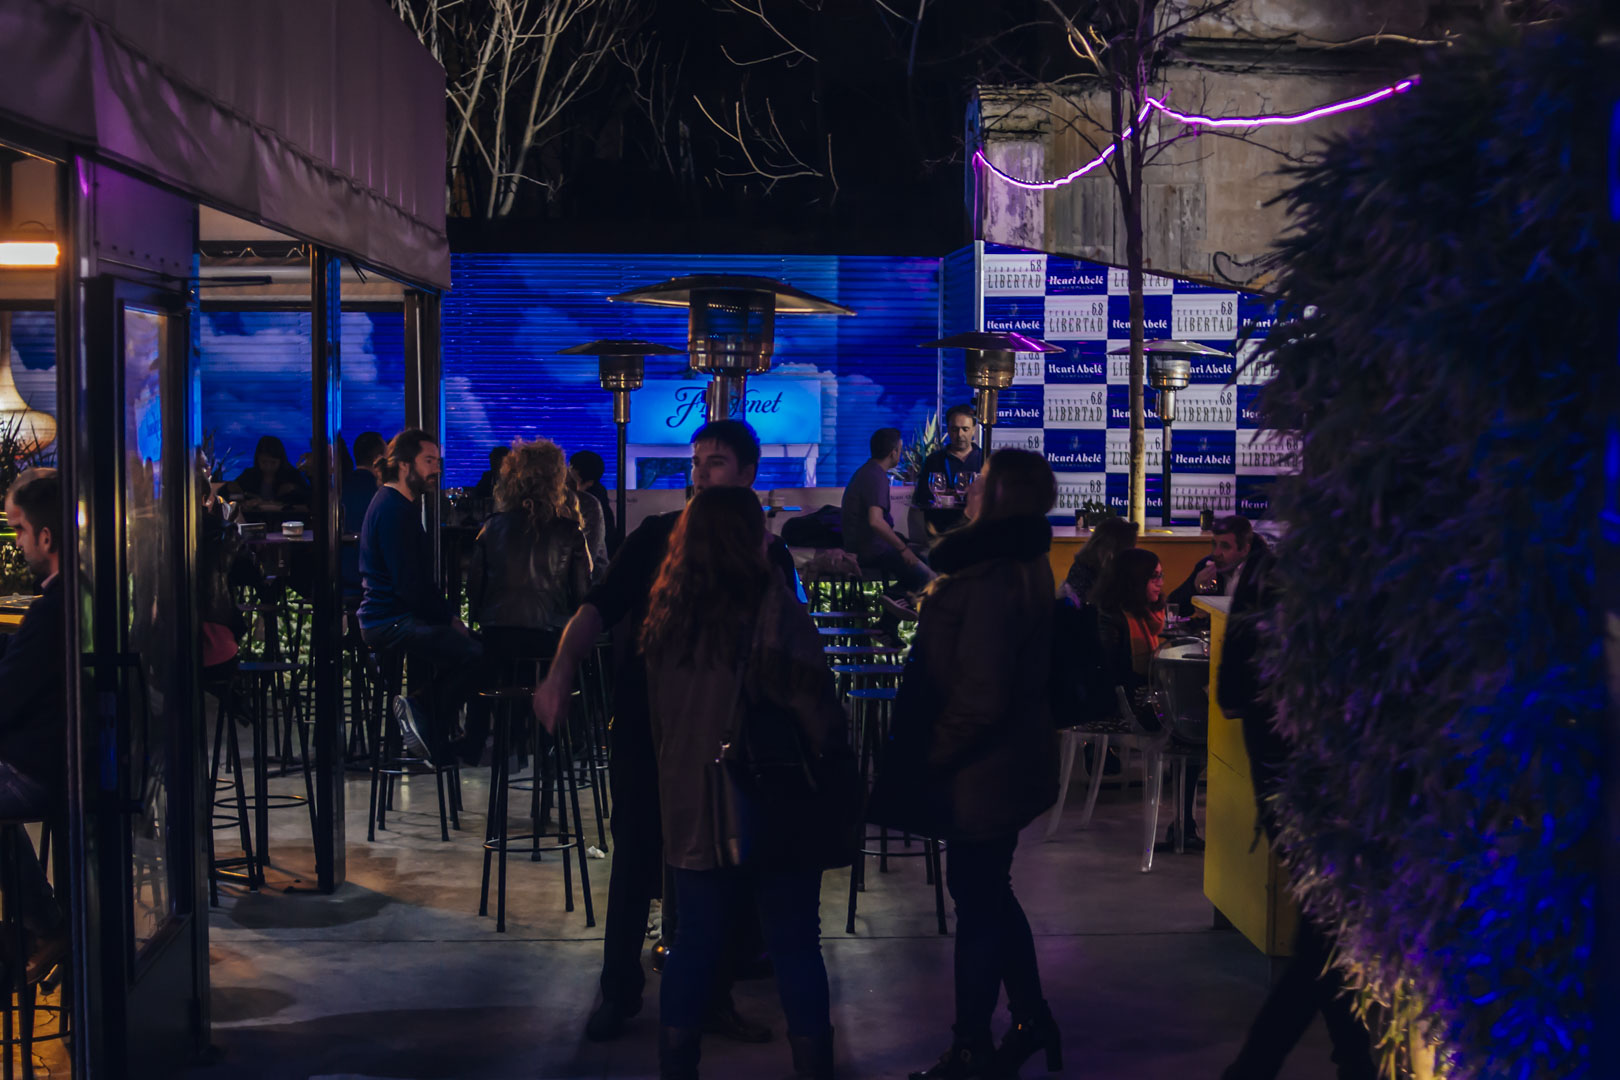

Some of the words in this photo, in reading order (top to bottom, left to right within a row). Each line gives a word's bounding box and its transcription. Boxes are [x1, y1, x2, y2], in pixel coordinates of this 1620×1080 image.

[988, 274, 1041, 289] LIBERTAD
[1049, 275, 1076, 285] Henri
[1077, 275, 1104, 285] Abelé
[1091, 302, 1104, 316] 6.8
[1220, 302, 1233, 315] 6.8
[987, 320, 1013, 329] Henri
[1016, 320, 1040, 329] Abelé
[1050, 318, 1103, 332] LIBERTAD
[1112, 320, 1131, 329] Hen
[1177, 317, 1233, 332] LIBERTAD
[1048, 364, 1075, 374] Henri
[1076, 363, 1103, 374] Abelé
[1205, 365, 1232, 374] Abelé
[1091, 391, 1103, 405] 6.8
[1220, 392, 1232, 405] 6.8
[1015, 408, 1040, 417] Abelé
[1049, 407, 1102, 421] LIBERTAD
[1112, 409, 1130, 418] Hen
[1176, 407, 1232, 422] LIBERTAD
[1028, 436, 1040, 448] 6.8
[1047, 453, 1074, 462] Henri
[1075, 453, 1101, 463] Abelé
[1175, 454, 1203, 464] Henri
[1204, 454, 1231, 465] Abelé
[1219, 482, 1231, 495] 6.8
[1111, 497, 1129, 506] Hen
[1176, 496, 1231, 510] LIBERTAD
